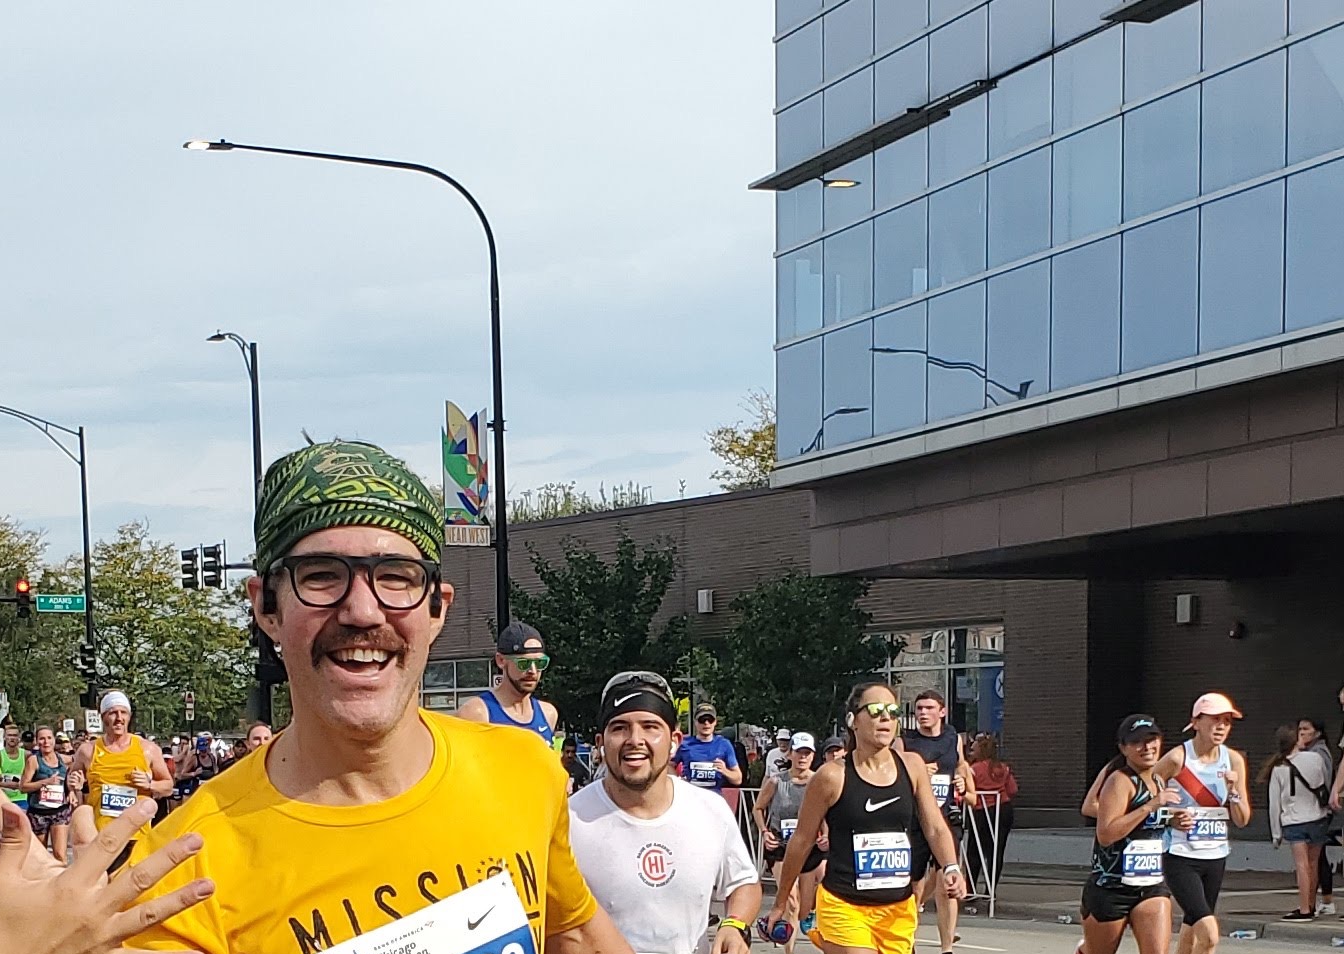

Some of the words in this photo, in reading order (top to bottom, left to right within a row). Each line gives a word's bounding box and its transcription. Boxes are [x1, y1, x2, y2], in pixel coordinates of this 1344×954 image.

[858, 852, 868, 870] F
[869, 850, 909, 870] 27060
[1125, 854, 1134, 870] F
[1134, 854, 1161, 870] 22051
